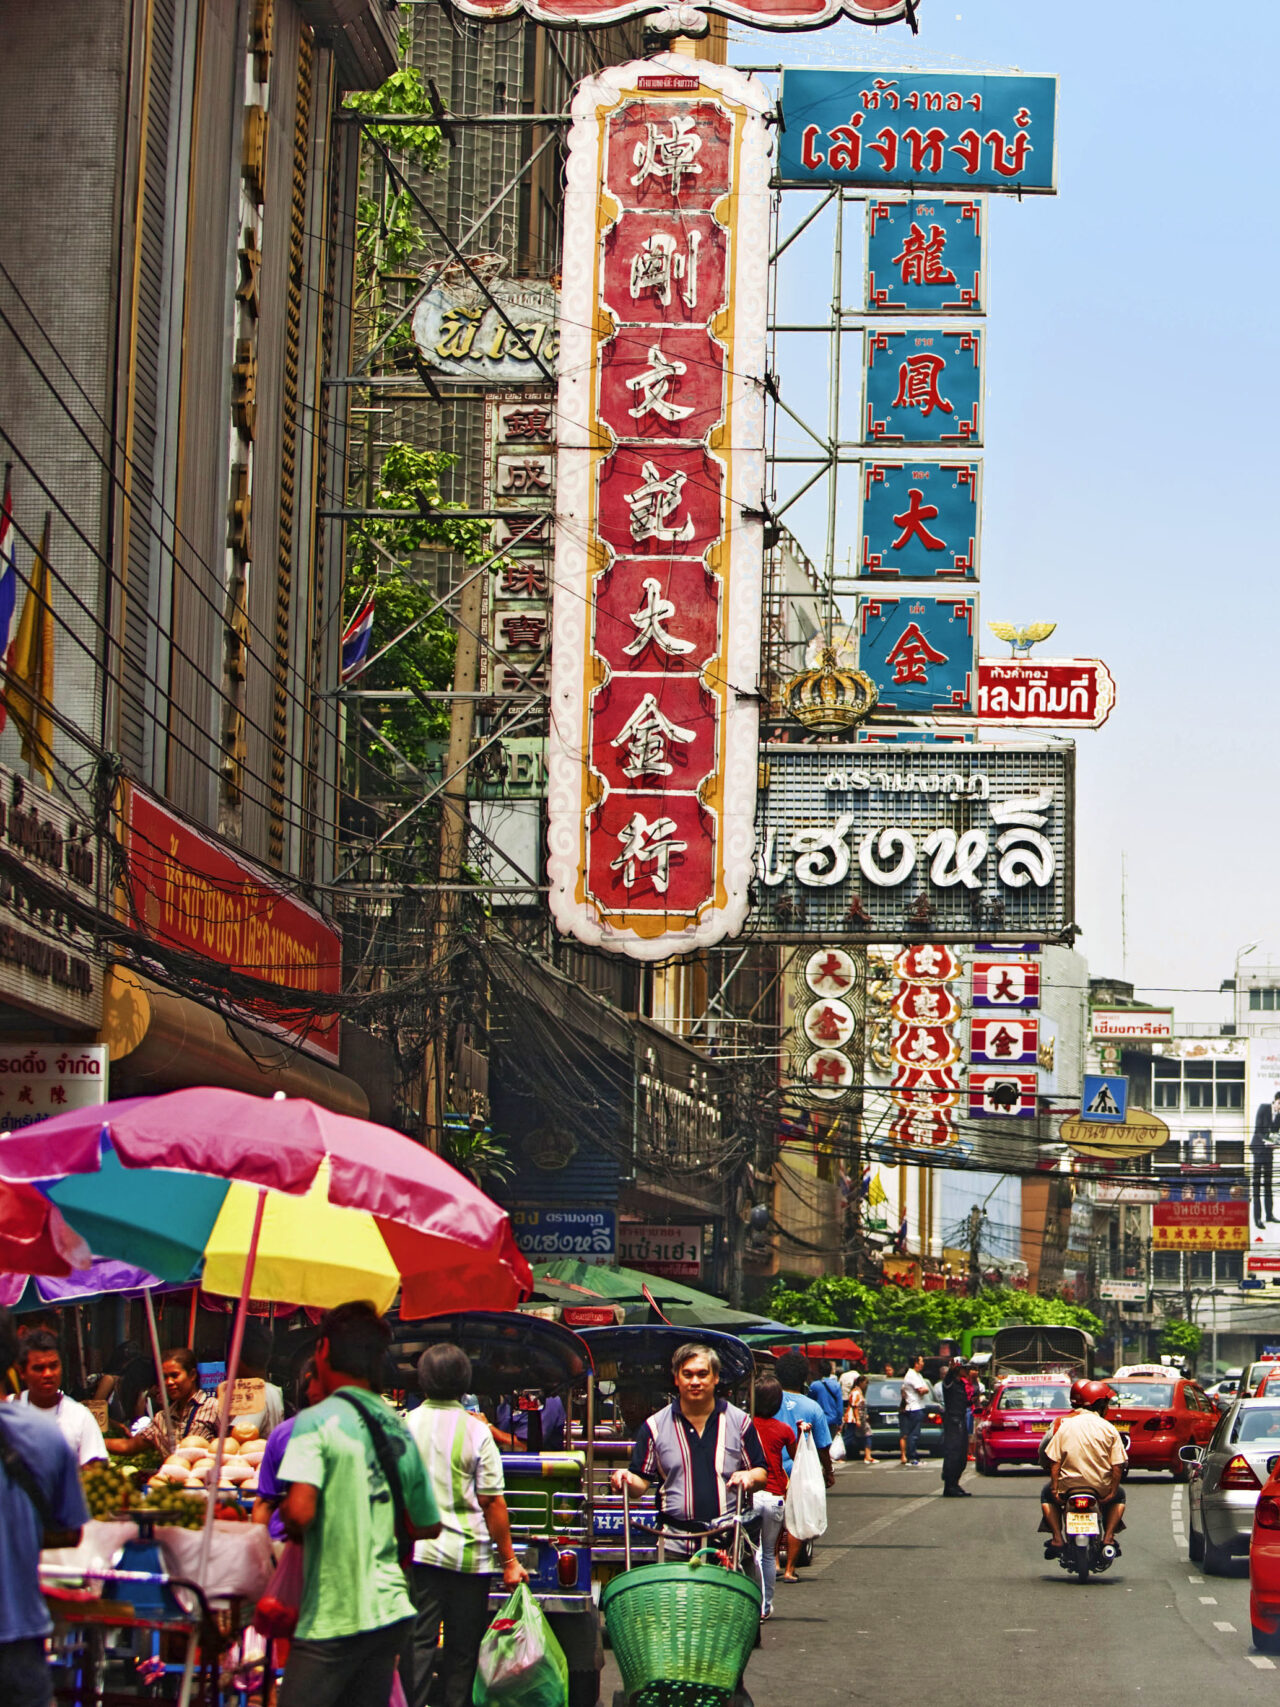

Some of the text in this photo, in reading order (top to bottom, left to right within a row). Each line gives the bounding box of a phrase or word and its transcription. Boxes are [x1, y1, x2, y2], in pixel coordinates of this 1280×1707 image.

[858, 78, 983, 112] ห้างทอง
[801, 107, 1034, 177] เล่งหงษ์
[55, 1053, 101, 1075] จำกัด
[990, 971, 1020, 1112] 大金
